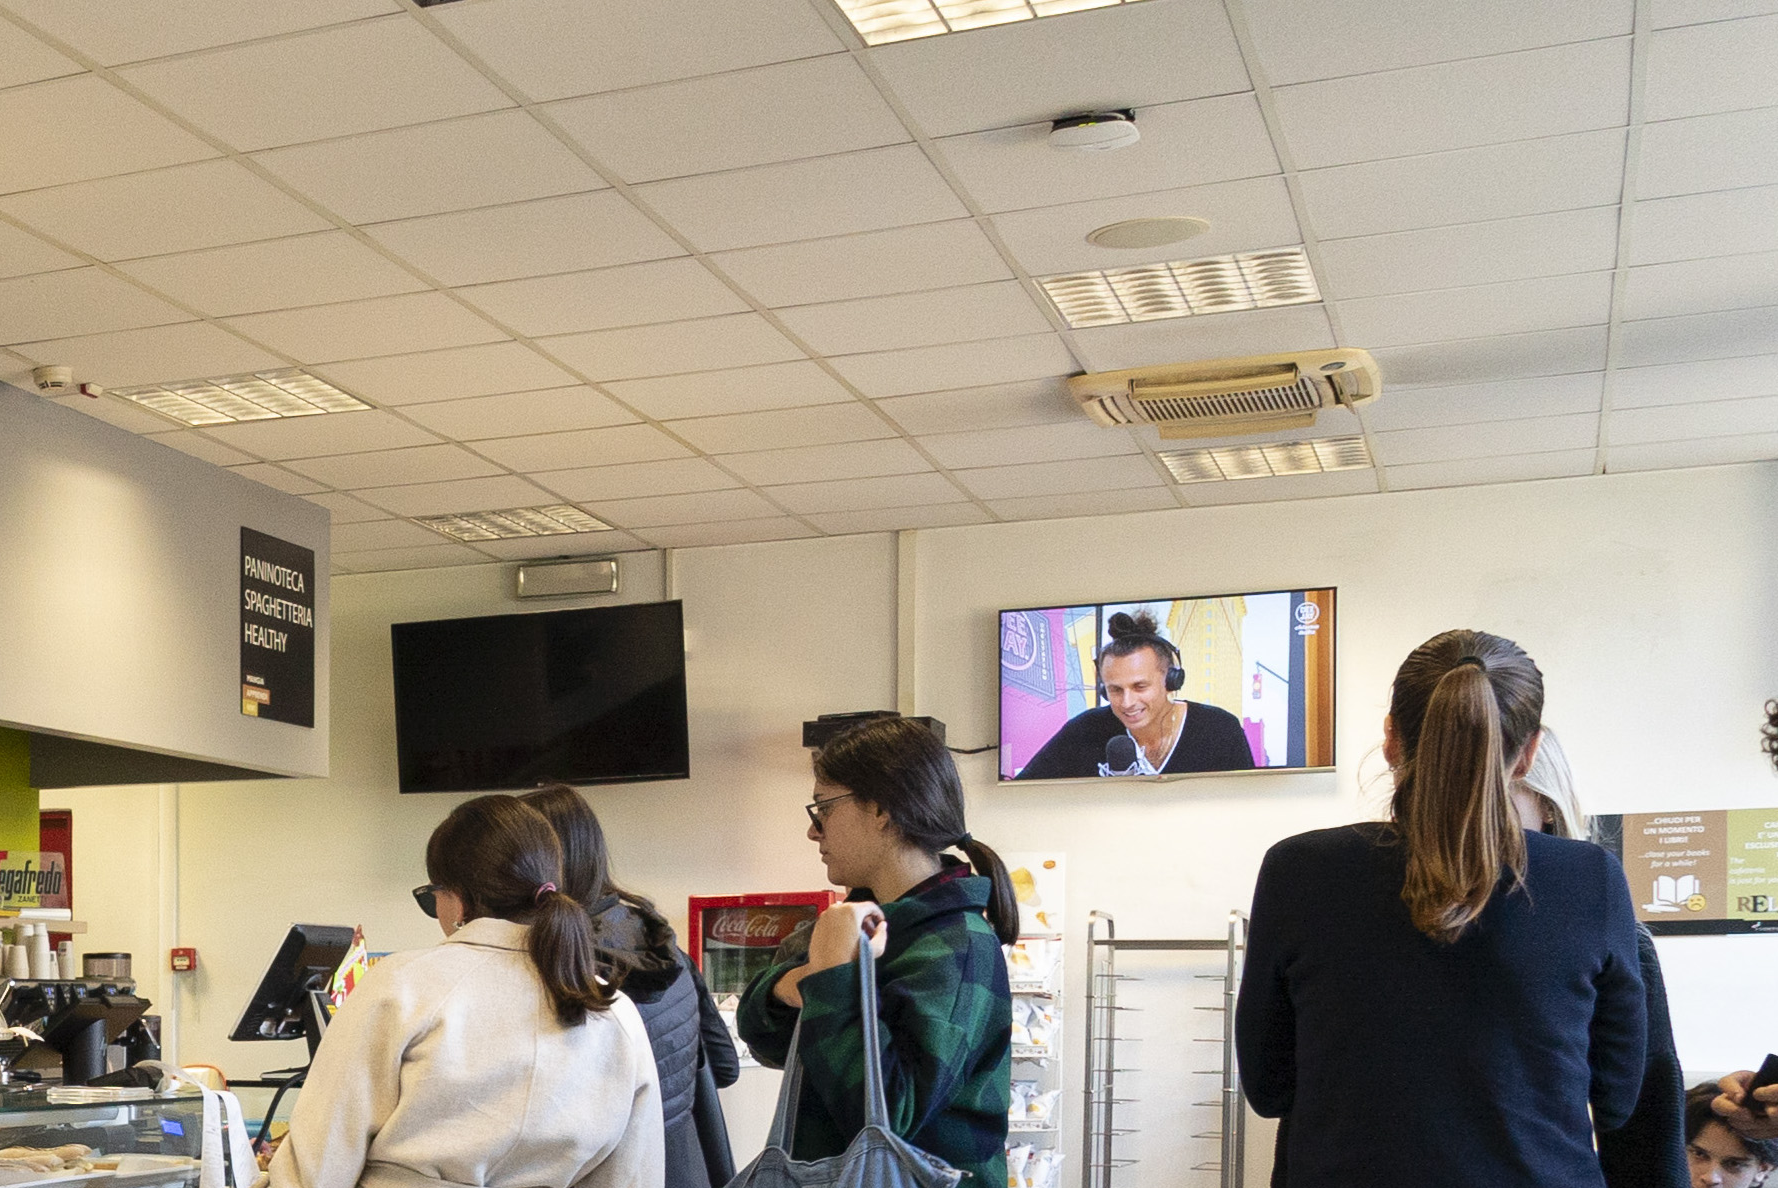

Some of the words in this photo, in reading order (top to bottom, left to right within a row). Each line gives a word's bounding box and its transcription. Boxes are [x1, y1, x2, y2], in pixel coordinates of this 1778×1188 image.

[245, 556, 304, 593] PANINOTECA
[245, 589, 313, 628] SPAGHETTERIA
[245, 623, 287, 652] HEALTHY
[1658, 826, 1705, 834] MOMENTO
[711, 914, 782, 938] Coca-Cola
